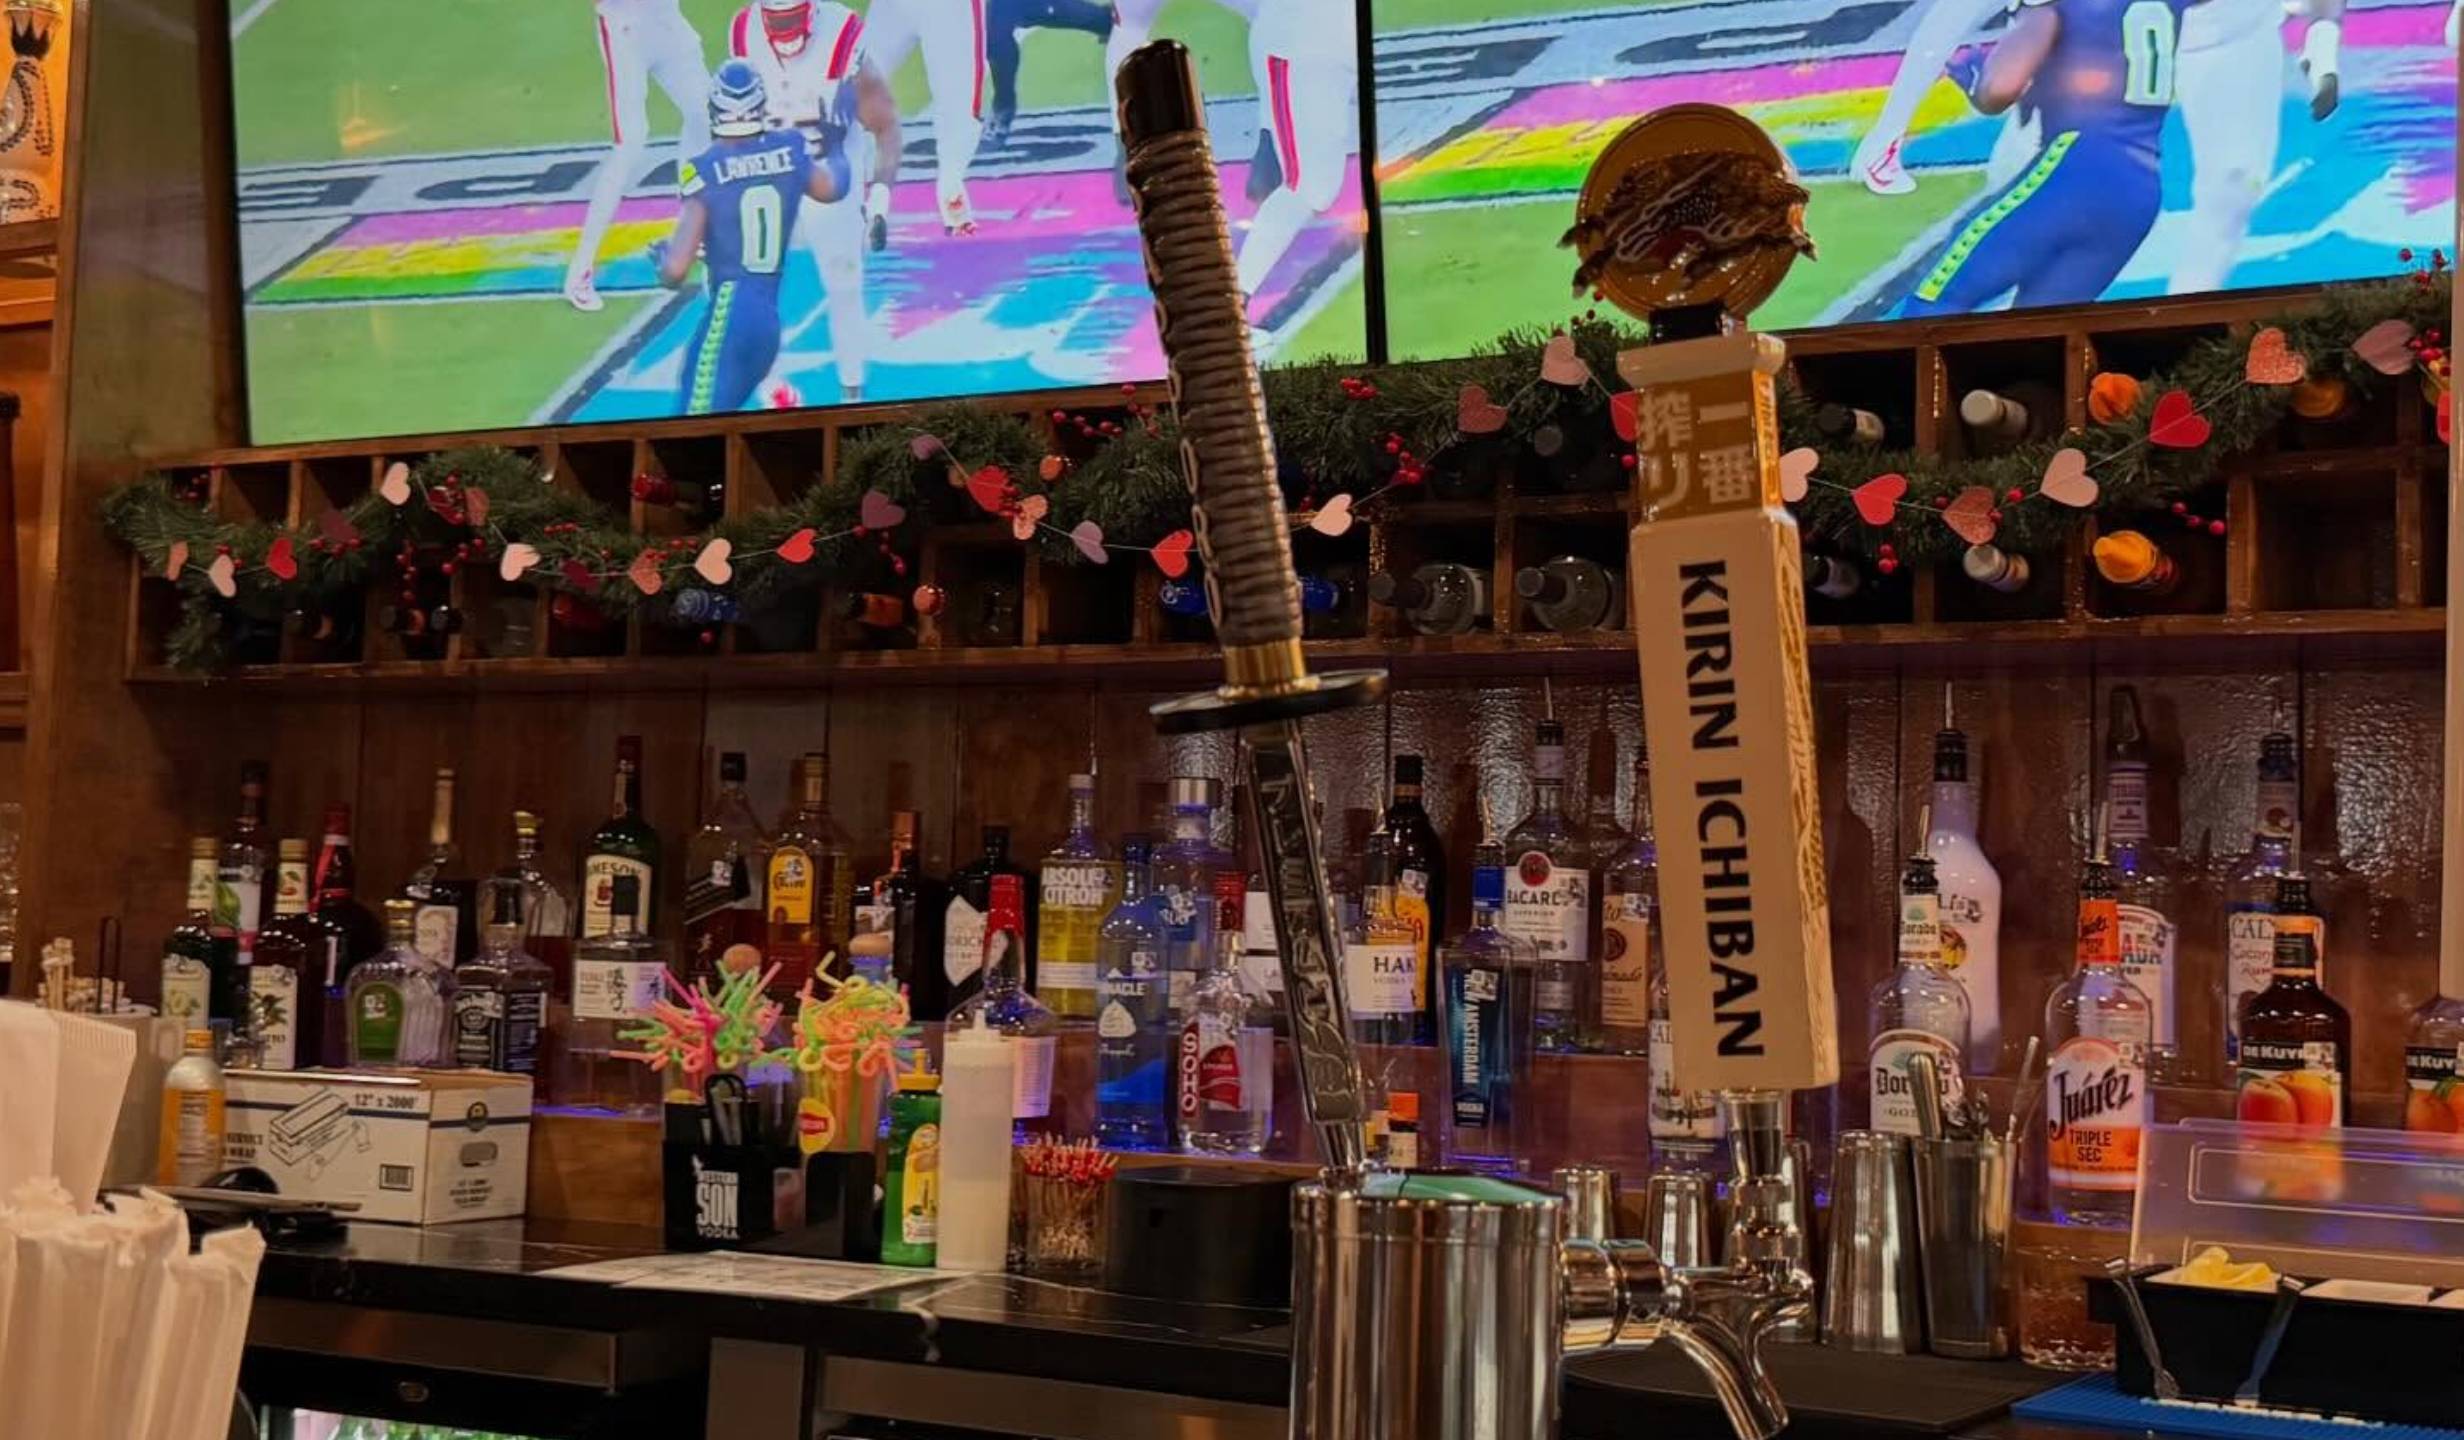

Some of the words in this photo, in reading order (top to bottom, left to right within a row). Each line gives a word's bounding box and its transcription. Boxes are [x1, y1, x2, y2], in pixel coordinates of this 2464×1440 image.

[740, 184, 782, 274] 0
[1679, 560, 1740, 750] KIRIN
[1695, 778, 1765, 1056] ICHIBAN
[1182, 1032, 1199, 1112] SOHO
[1463, 1003, 1480, 1083] AMSTERDAM
[2069, 1129, 2112, 1147] TRIPLE
[2077, 1147, 2102, 1162] SEC
[697, 1182, 738, 1227] SON
